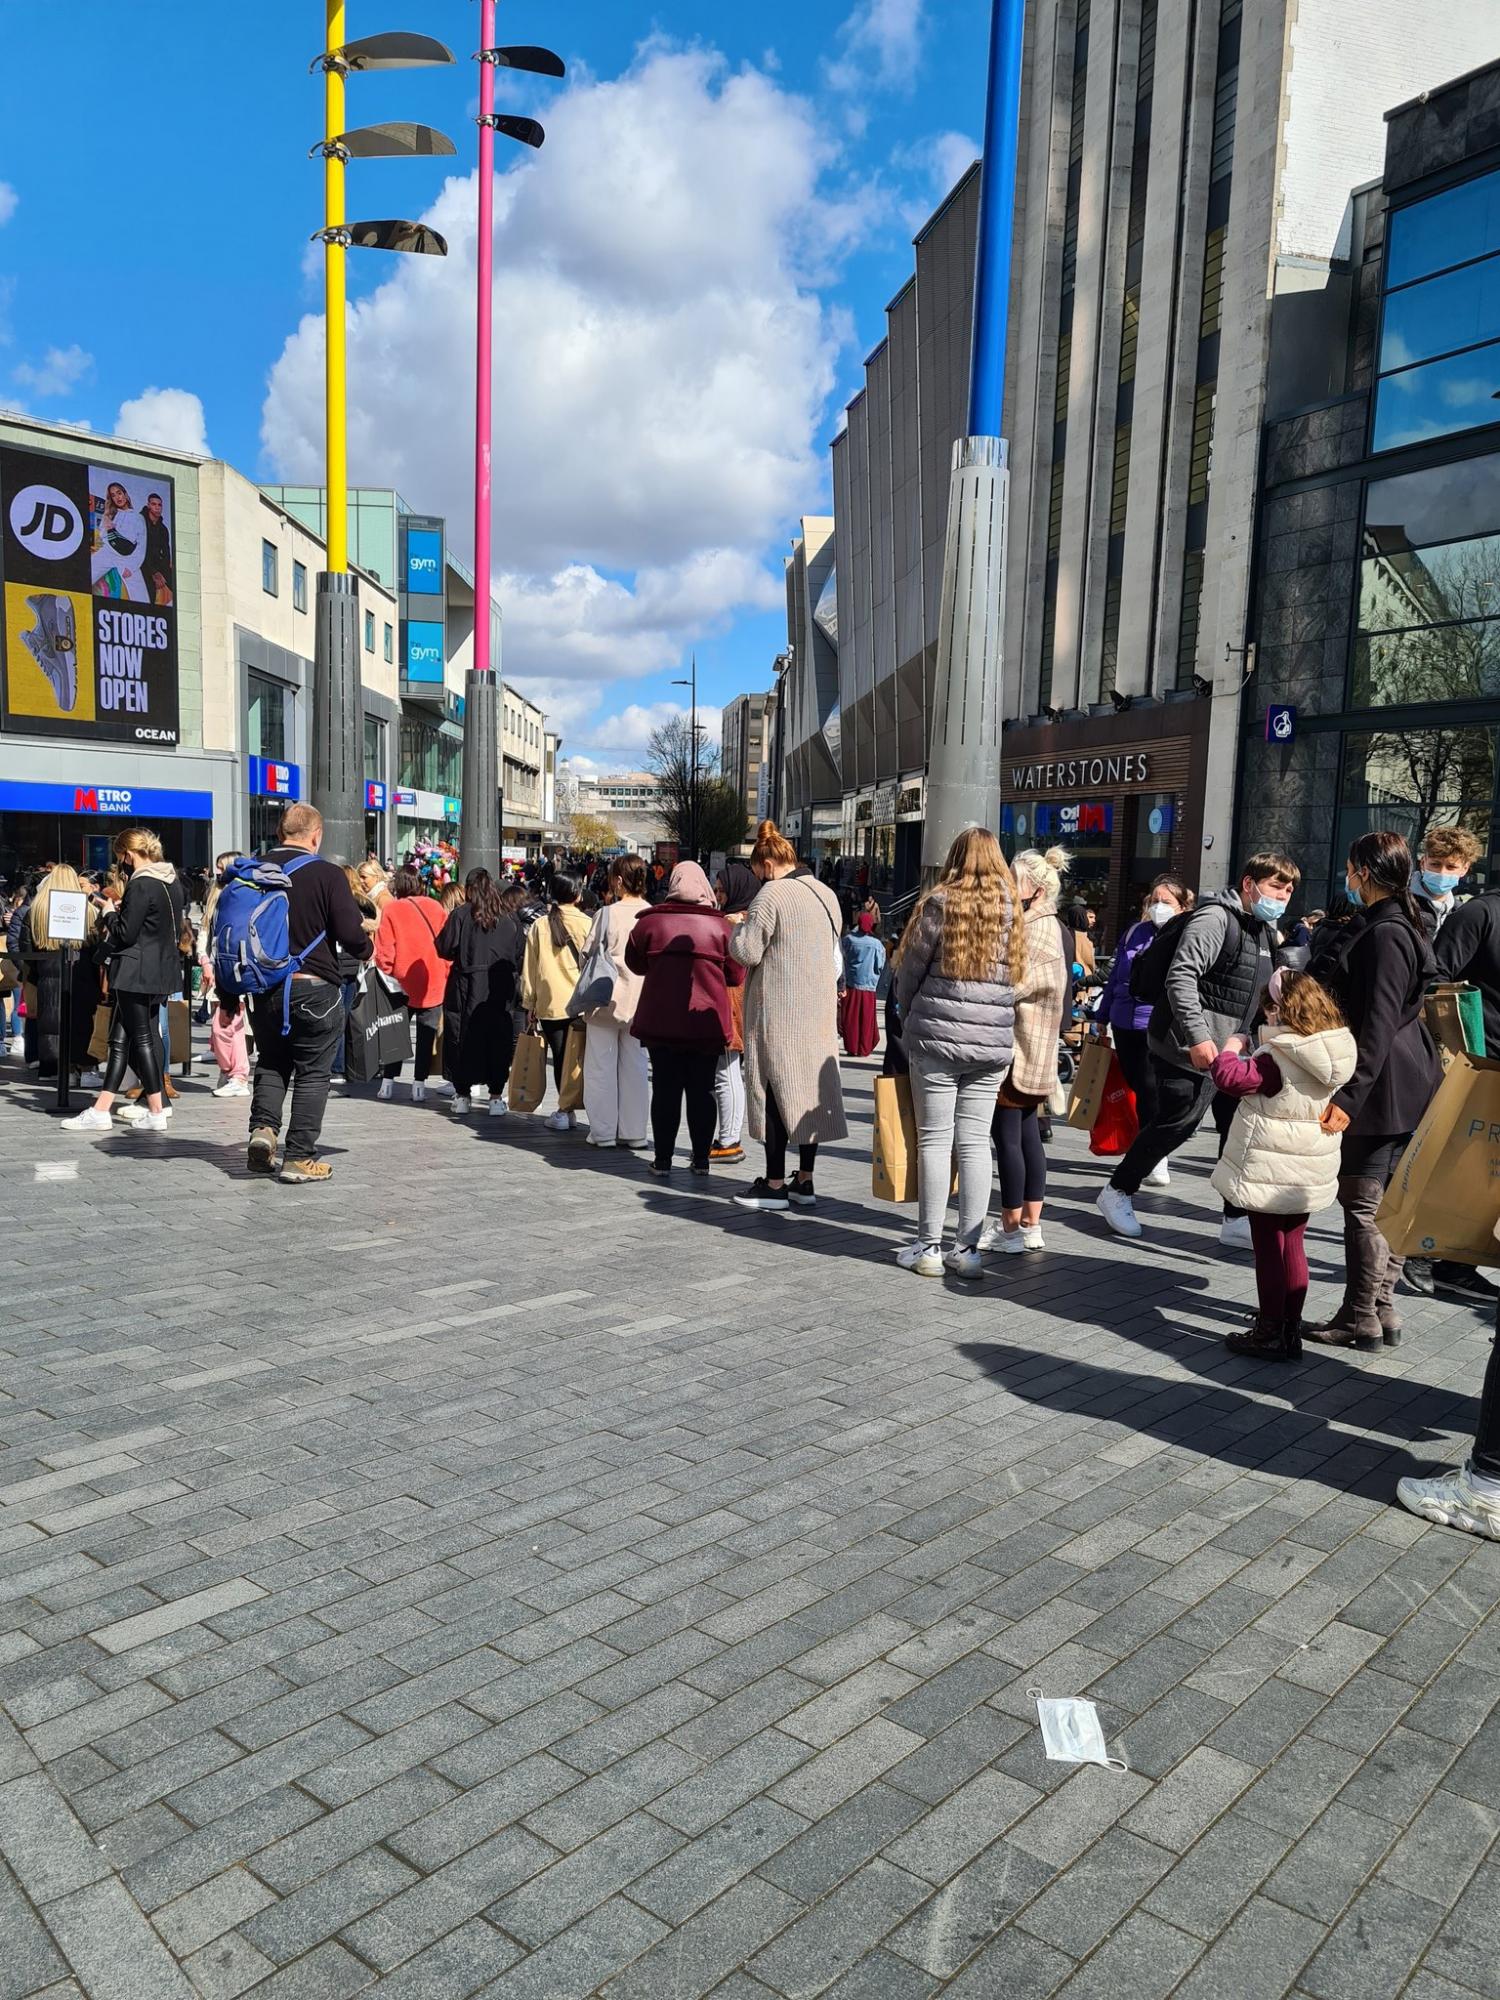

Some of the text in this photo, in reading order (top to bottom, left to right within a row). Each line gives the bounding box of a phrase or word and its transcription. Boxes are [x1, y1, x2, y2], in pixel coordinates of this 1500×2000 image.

[20, 502, 75, 541] JD
[410, 558, 436, 570] gym
[98, 609, 168, 650] STORES
[100, 642, 144, 680] NOW
[411, 647, 439, 660] gym
[100, 677, 148, 713] OPEN
[135, 728, 176, 741] OCEAN
[1012, 753, 1147, 790] WATERSTONES
[74, 788, 132, 812] METRO
[99, 803, 132, 813] BANK
